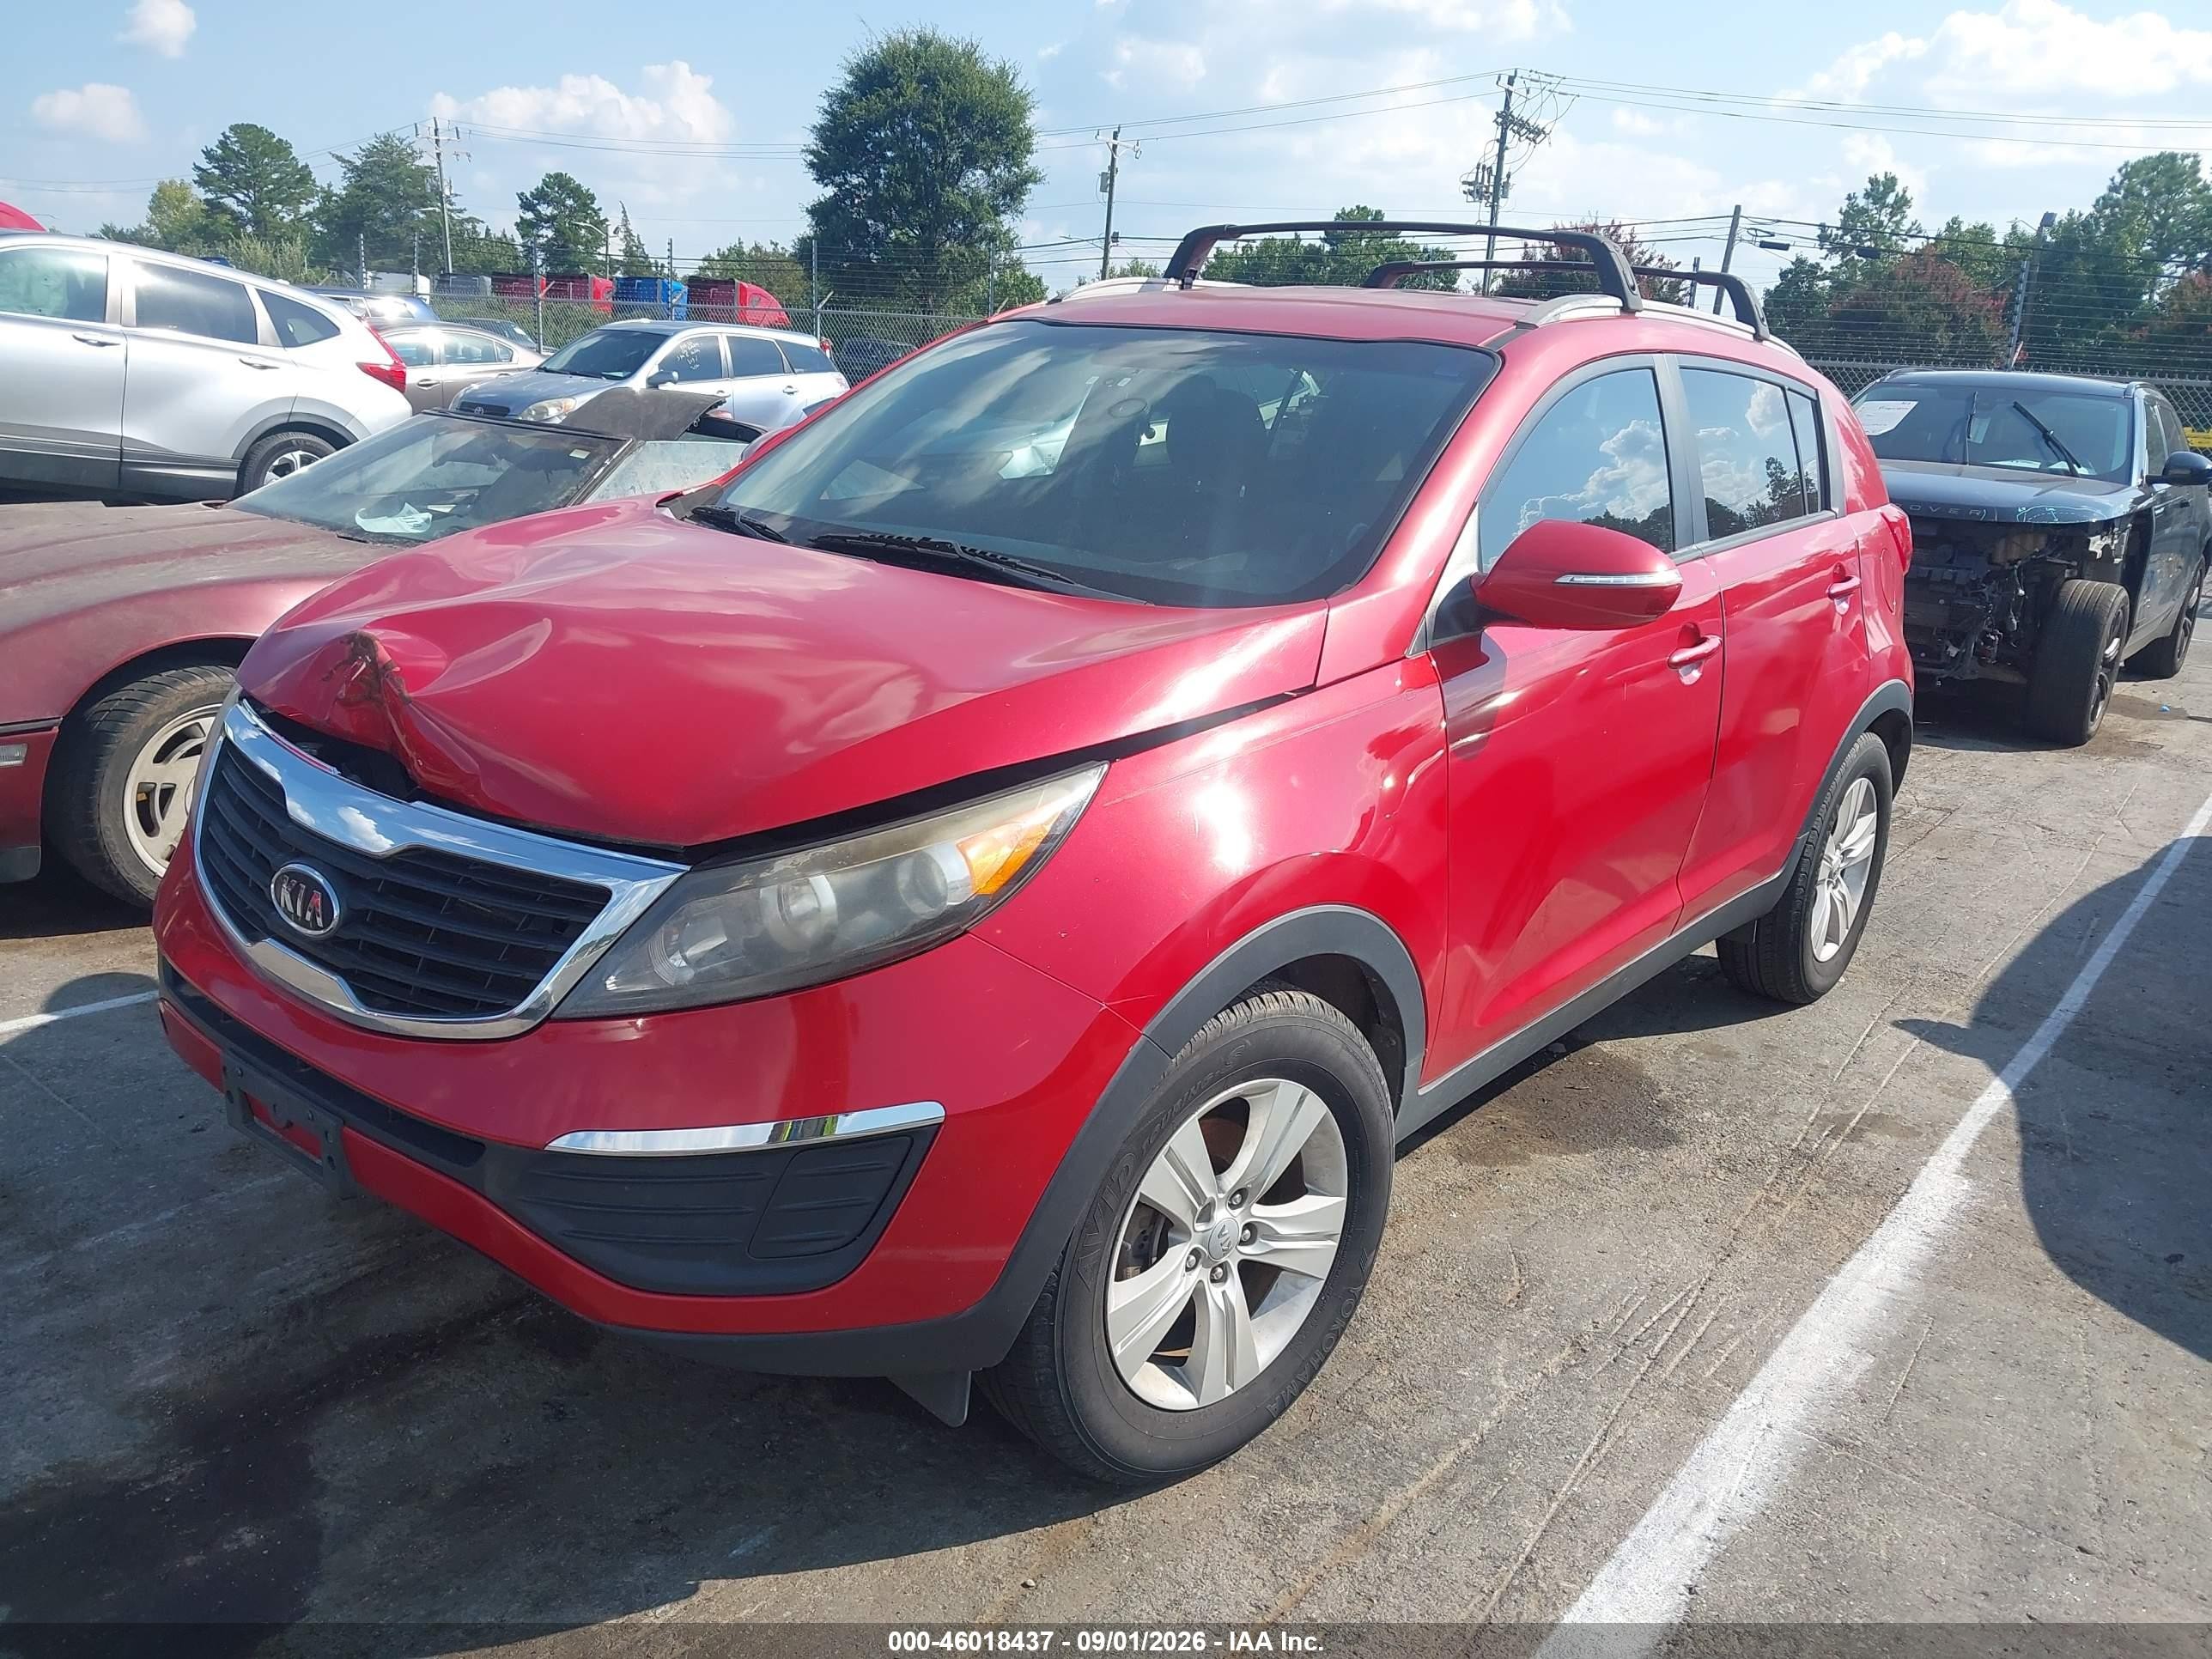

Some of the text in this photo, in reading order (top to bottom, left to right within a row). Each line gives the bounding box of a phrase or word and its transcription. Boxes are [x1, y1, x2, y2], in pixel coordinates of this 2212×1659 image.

[1899, 503, 1981, 516] OVER
[280, 874, 324, 927] KIA
[1266, 1283, 1365, 1418] YOKOHAMA
